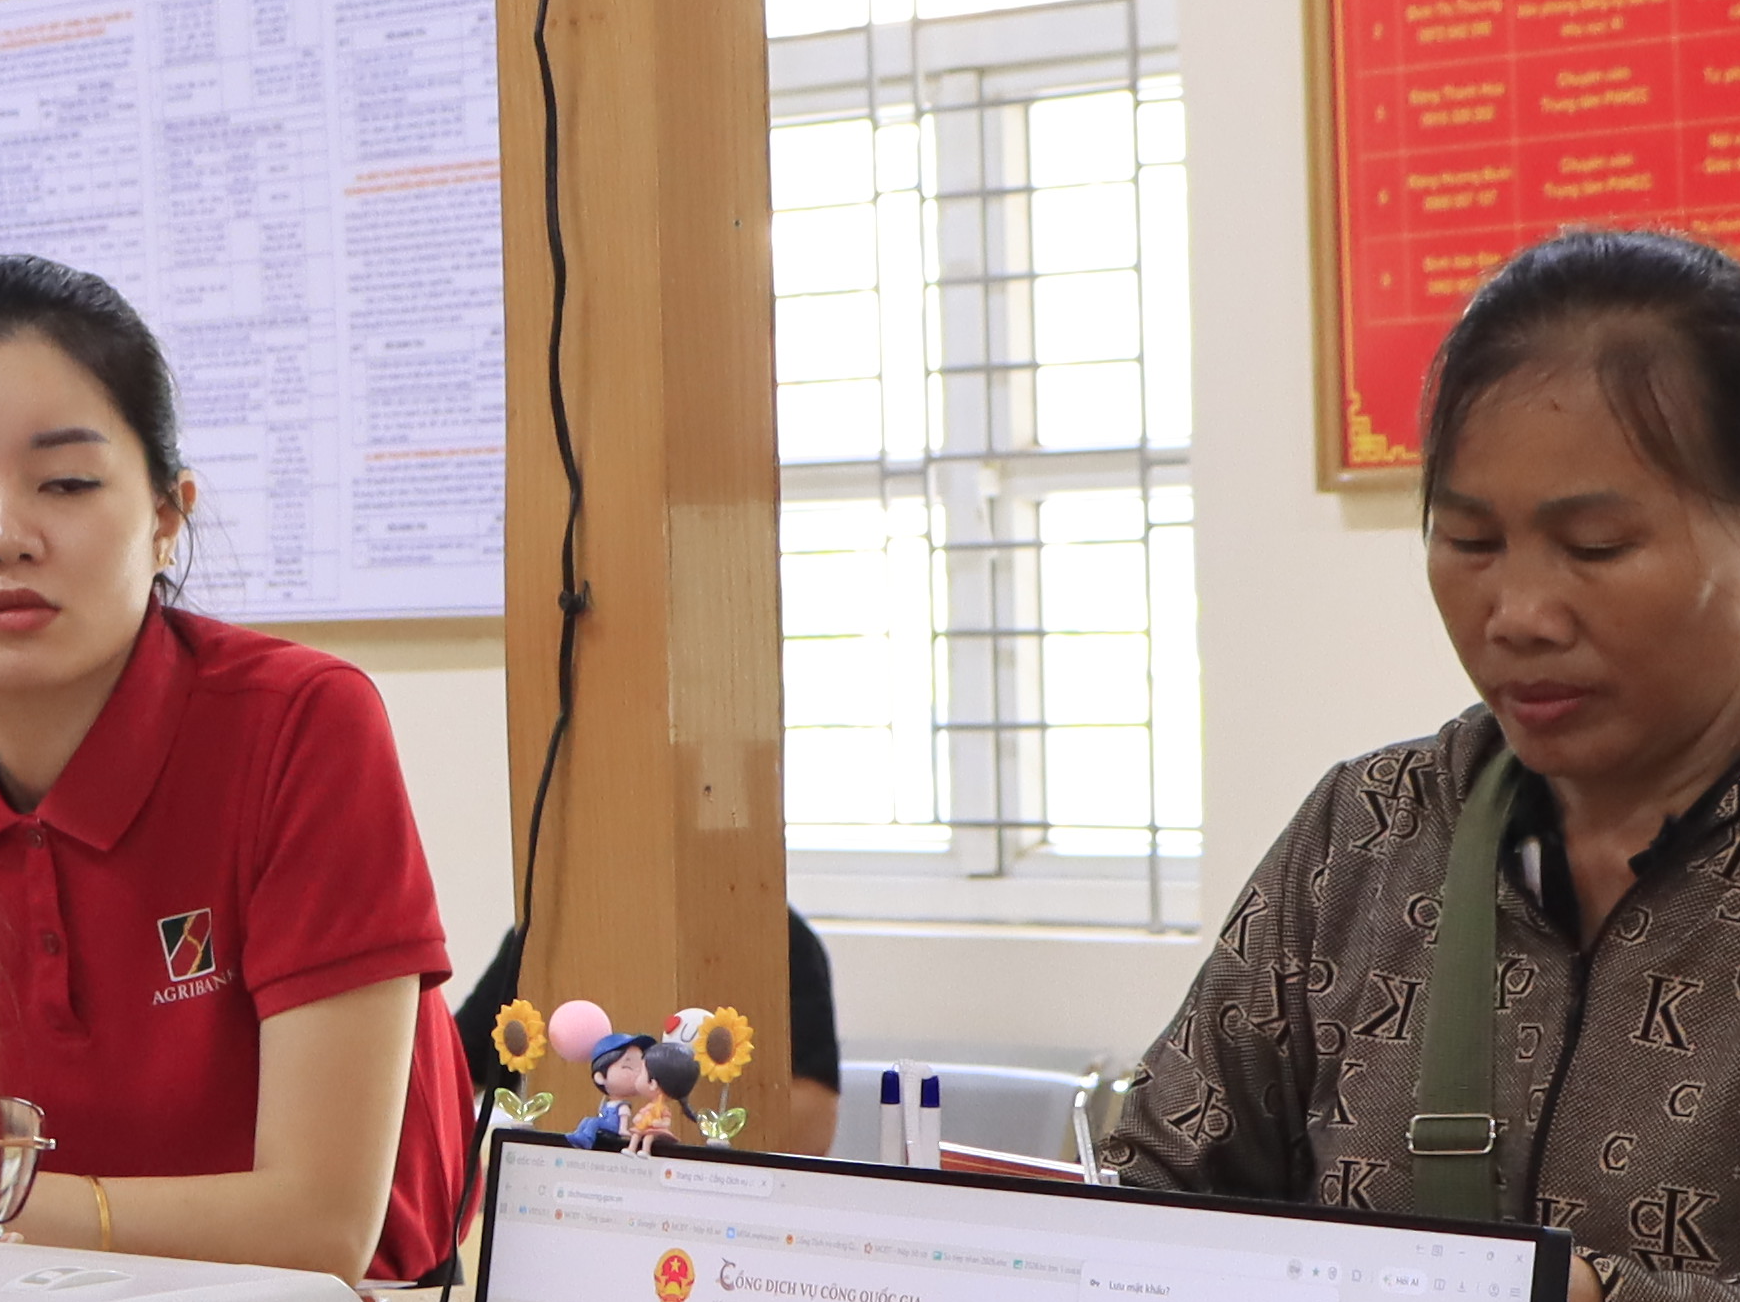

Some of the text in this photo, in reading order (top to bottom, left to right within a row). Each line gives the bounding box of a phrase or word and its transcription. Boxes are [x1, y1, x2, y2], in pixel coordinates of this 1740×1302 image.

[765, 1278, 797, 1296] DỊCH
[800, 1282, 819, 1299] VỤ
[820, 1284, 857, 1302] CÔNG
